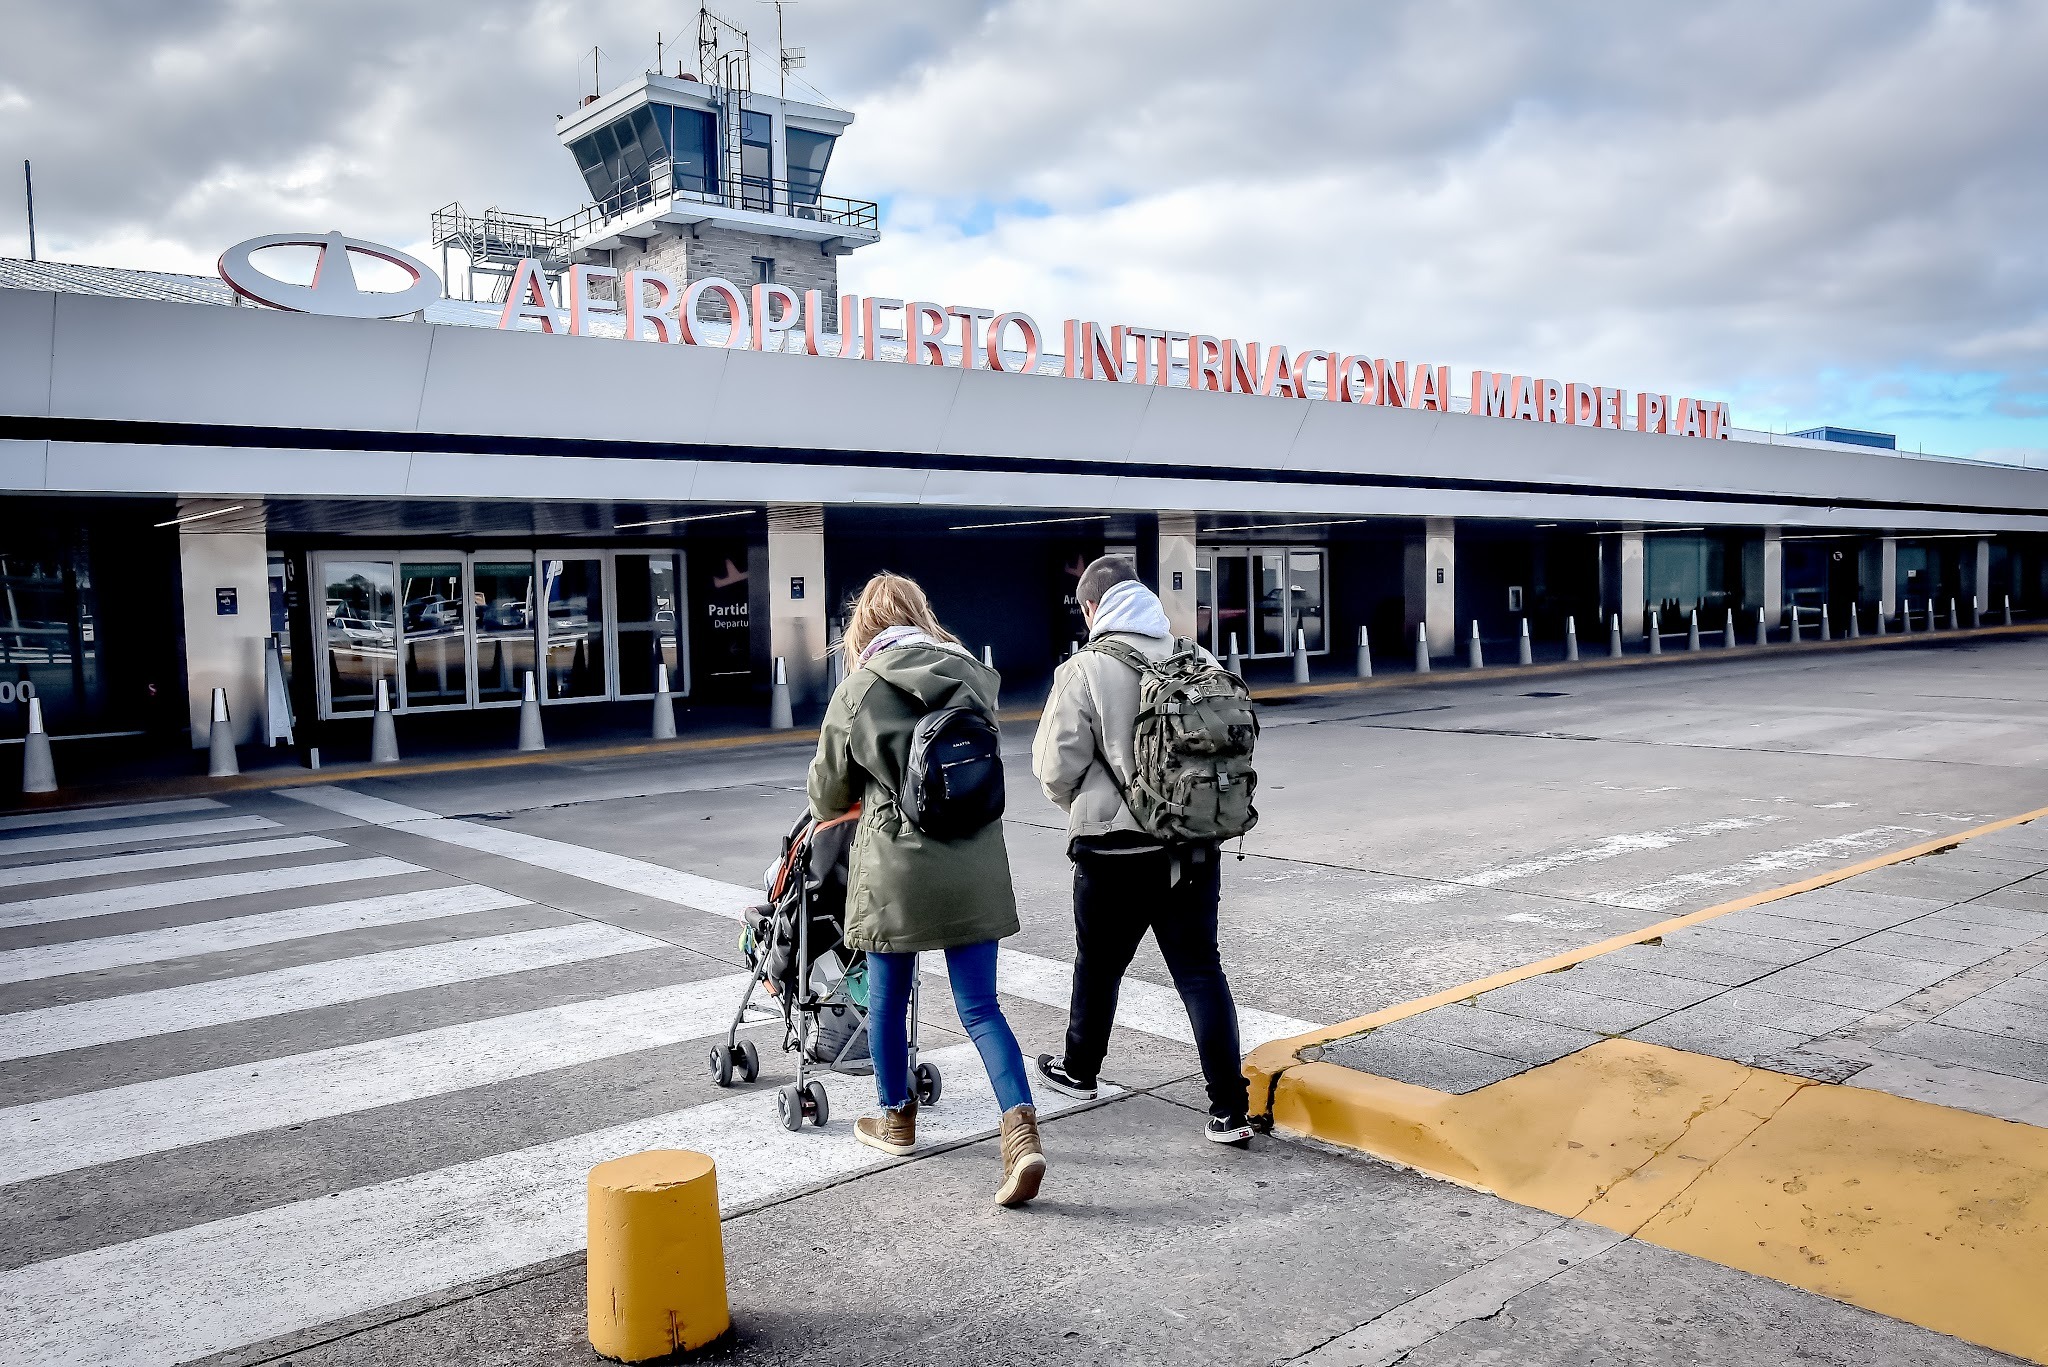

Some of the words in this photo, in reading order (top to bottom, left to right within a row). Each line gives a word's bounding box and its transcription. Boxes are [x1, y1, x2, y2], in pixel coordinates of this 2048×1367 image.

[498, 258, 1043, 375] AEROPUERTO
[1064, 319, 1451, 412] INTERNACIONAL
[1472, 371, 1565, 424] MAR
[1566, 383, 1629, 430] DEL
[1637, 393, 1733, 440] PLATA
[1064, 595, 1078, 605] Arr
[708, 603, 748, 616] Partid
[714, 619, 749, 630] Departu
